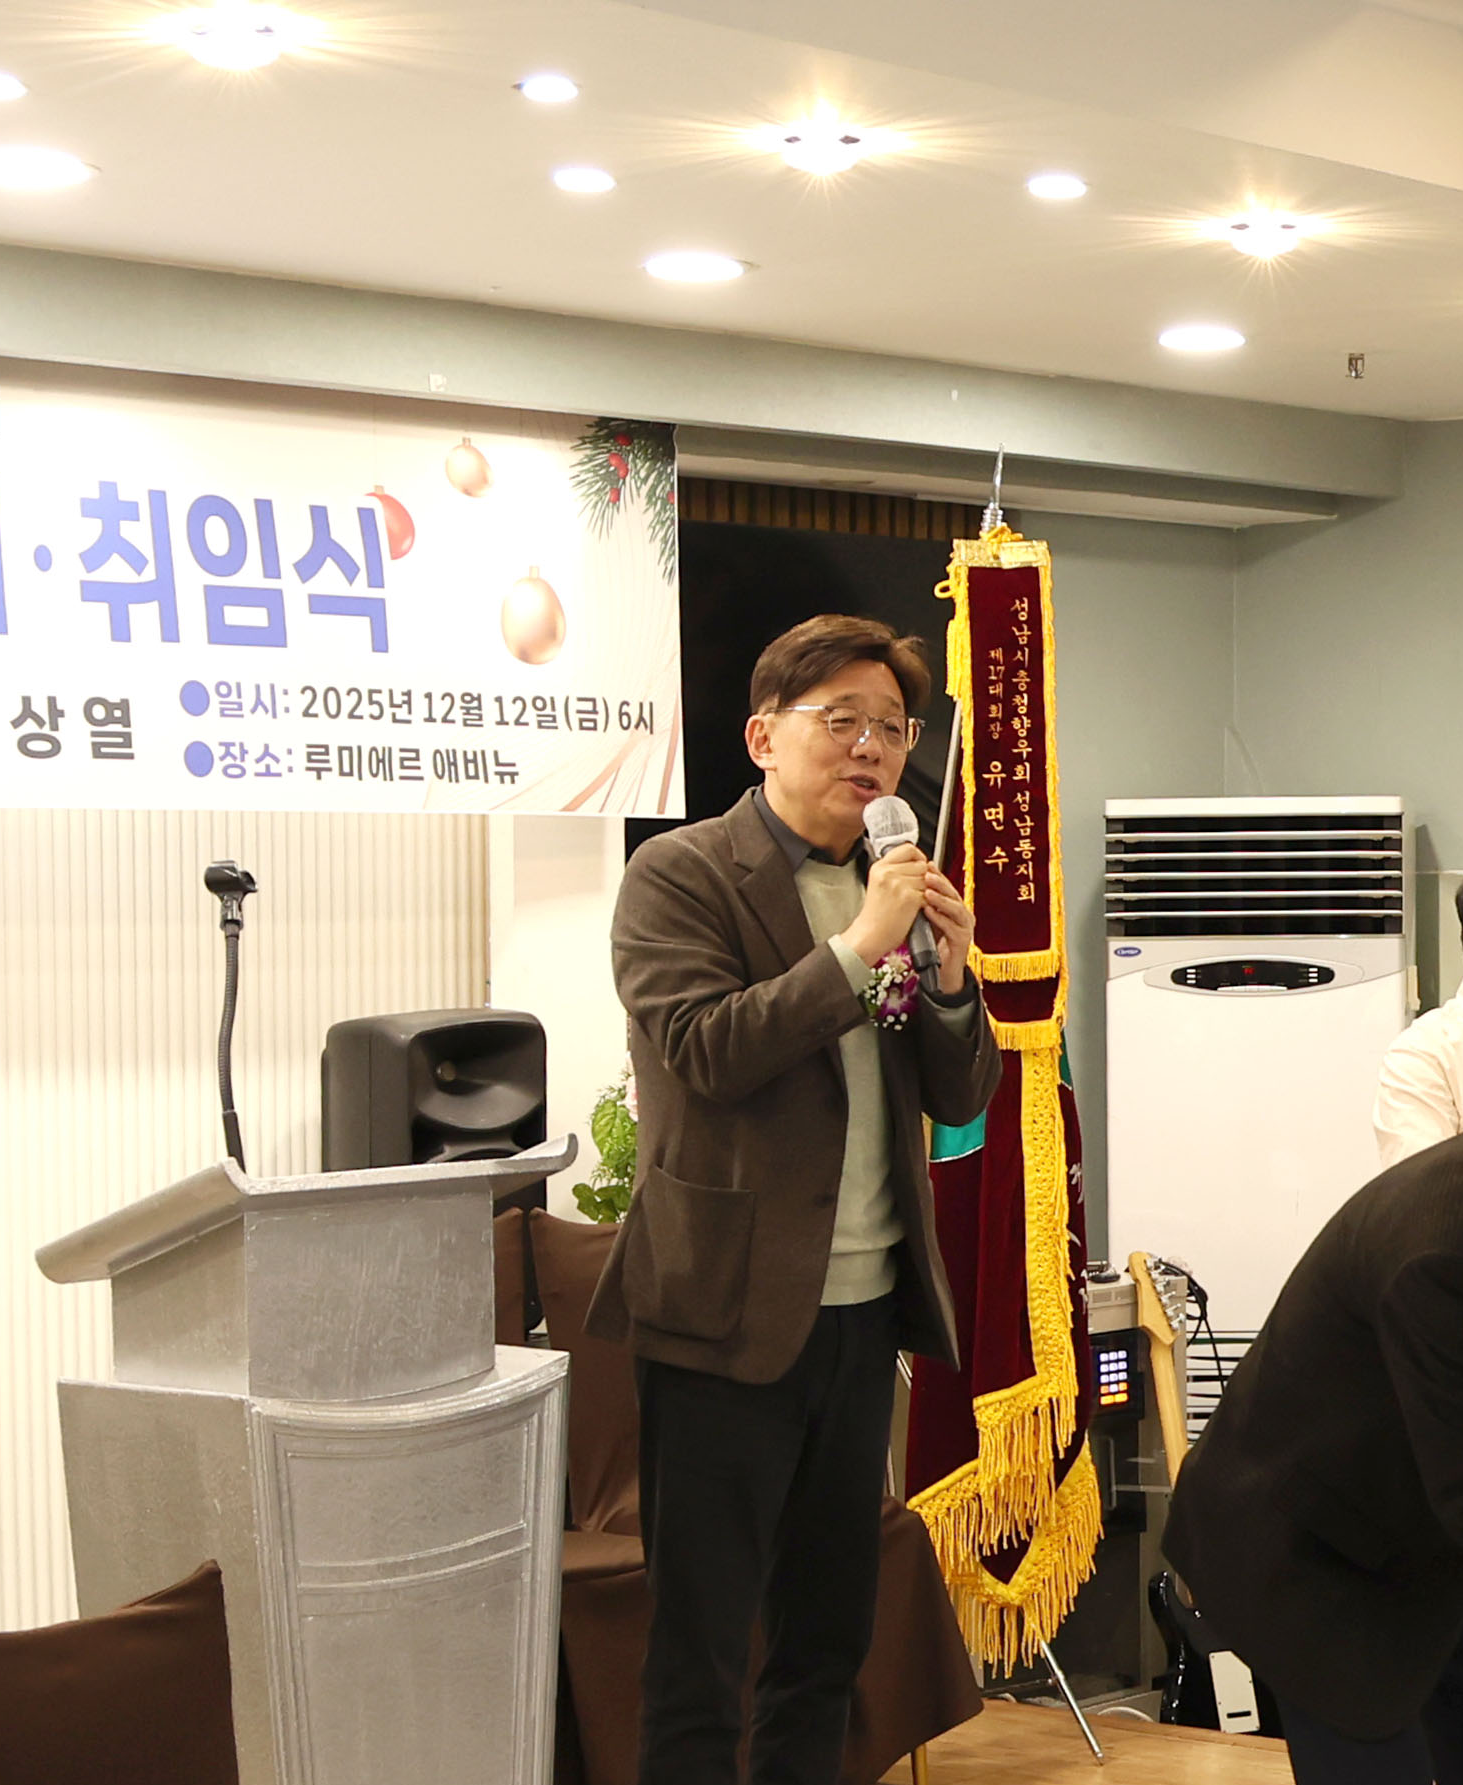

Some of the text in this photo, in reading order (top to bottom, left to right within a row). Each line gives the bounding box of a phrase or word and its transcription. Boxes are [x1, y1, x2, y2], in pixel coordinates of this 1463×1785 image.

[214, 680, 654, 735] 일시: 2025년 12월 12일(금) 6시
[219, 741, 520, 785] 장소: 루미에르 애비뉴
[1012, 790, 1036, 904] 성남동지회
